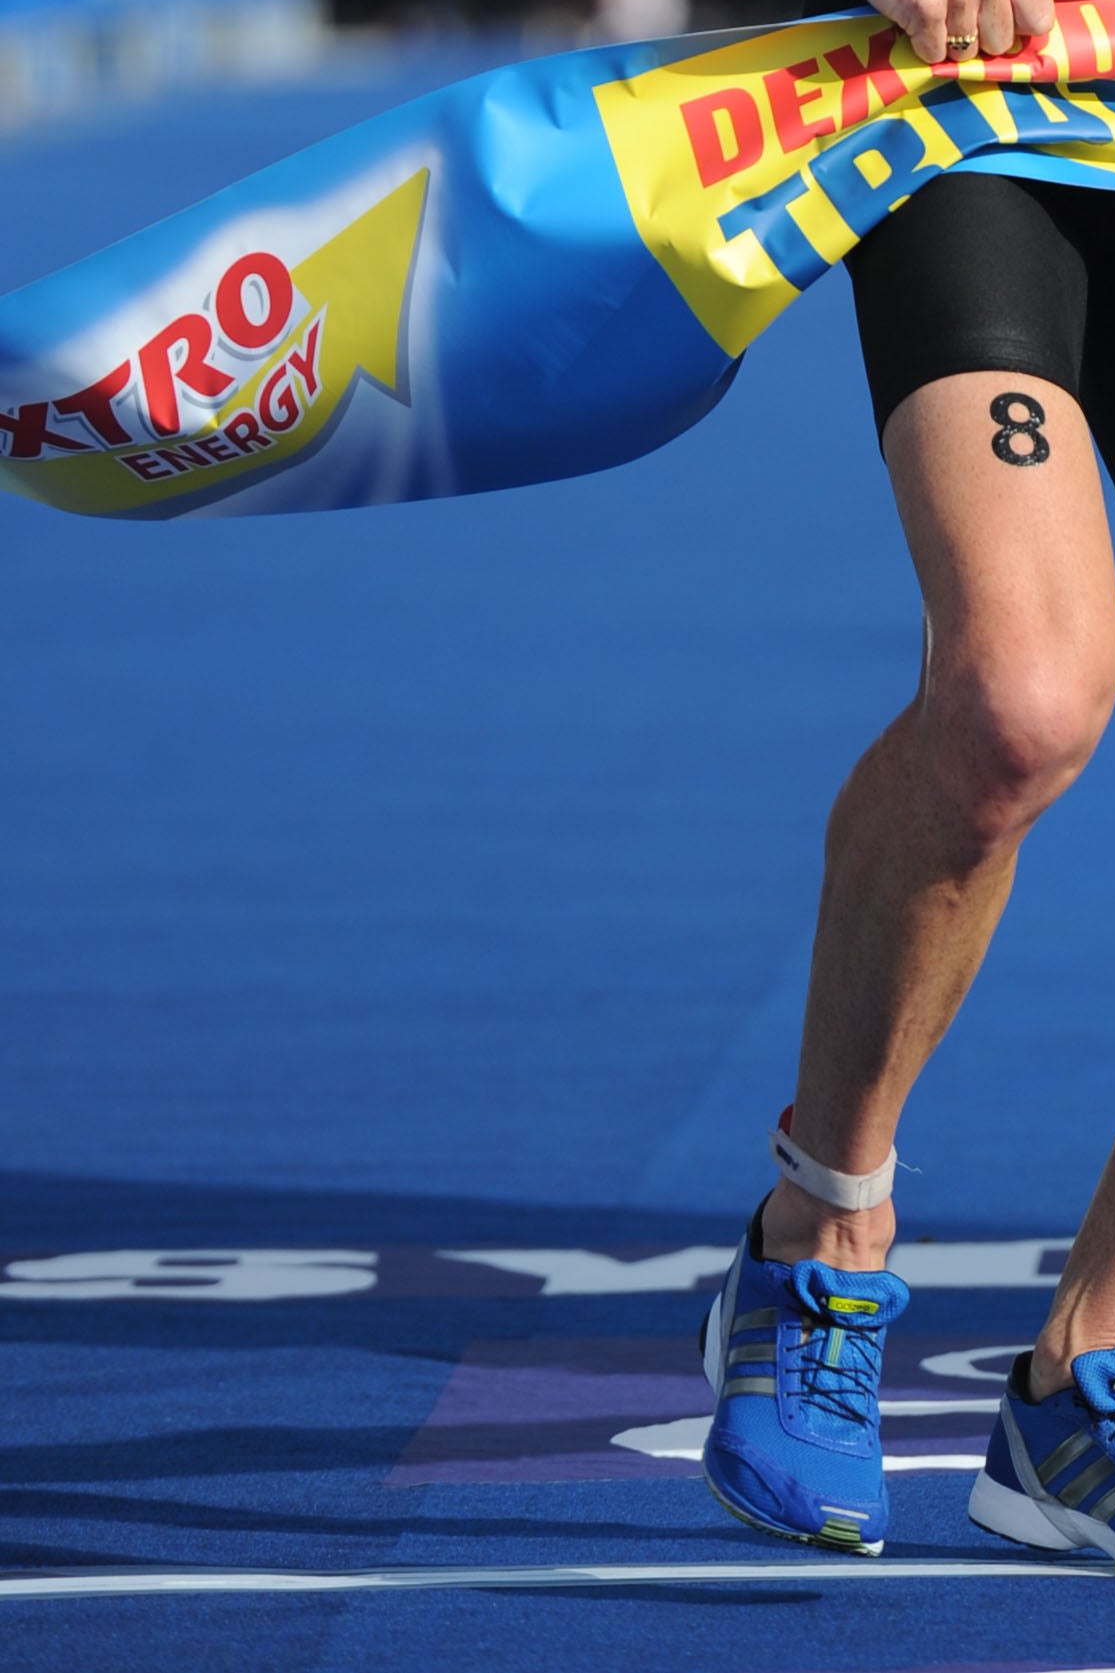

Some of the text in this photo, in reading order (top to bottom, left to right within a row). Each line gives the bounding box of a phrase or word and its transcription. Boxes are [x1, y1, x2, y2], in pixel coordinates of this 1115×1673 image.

[0, 252, 293, 459] XTRO
[118, 319, 322, 482] ENERGY
[989, 391, 1051, 467] 8
